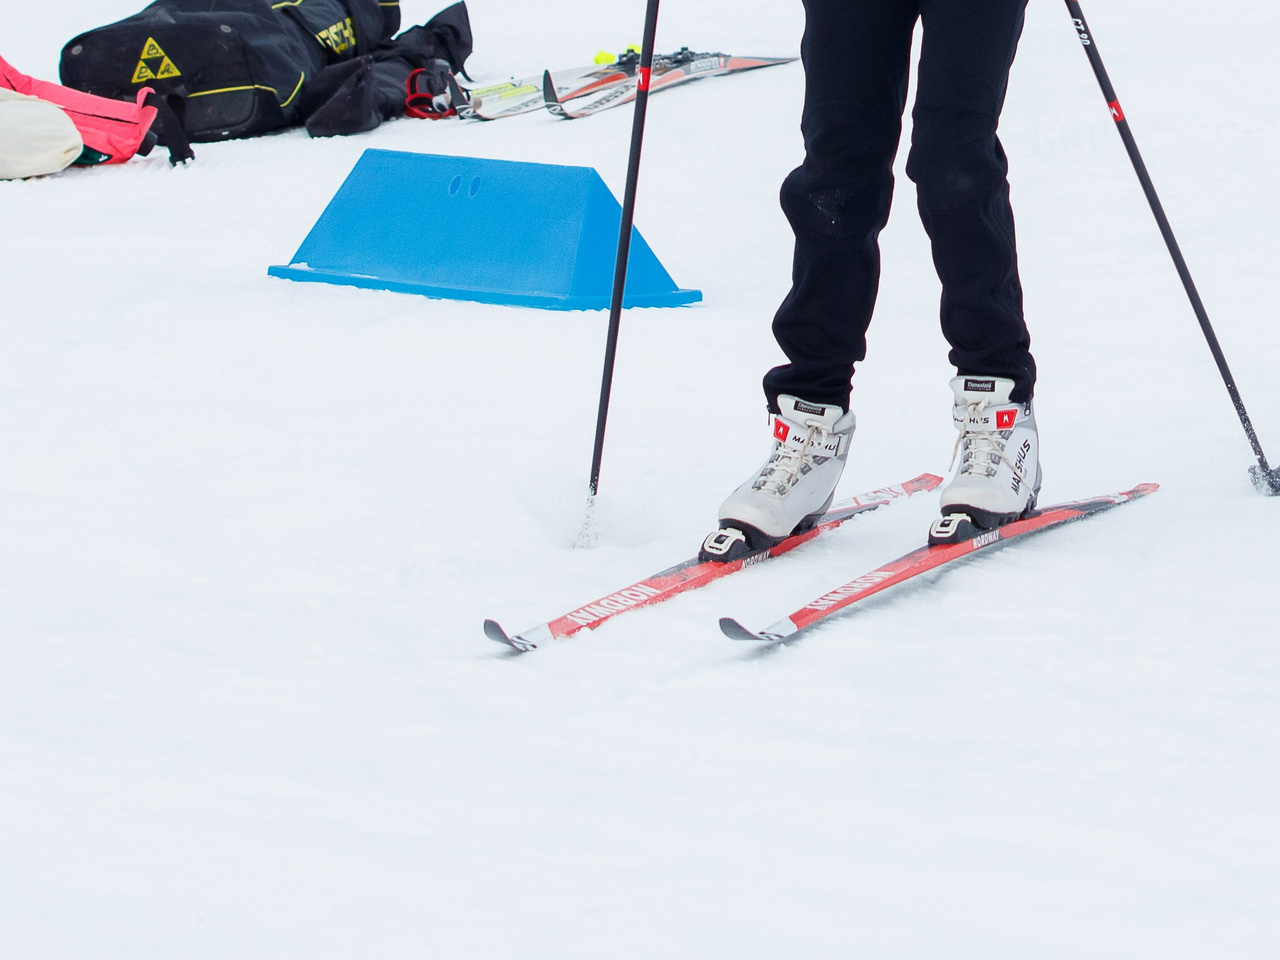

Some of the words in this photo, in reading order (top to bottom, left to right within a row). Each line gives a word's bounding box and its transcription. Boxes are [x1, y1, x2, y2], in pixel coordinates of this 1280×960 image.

[972, 530, 1000, 549] NORDWAY
[741, 550, 771, 570] NORDWAY
[565, 583, 662, 626] NORDWAY
